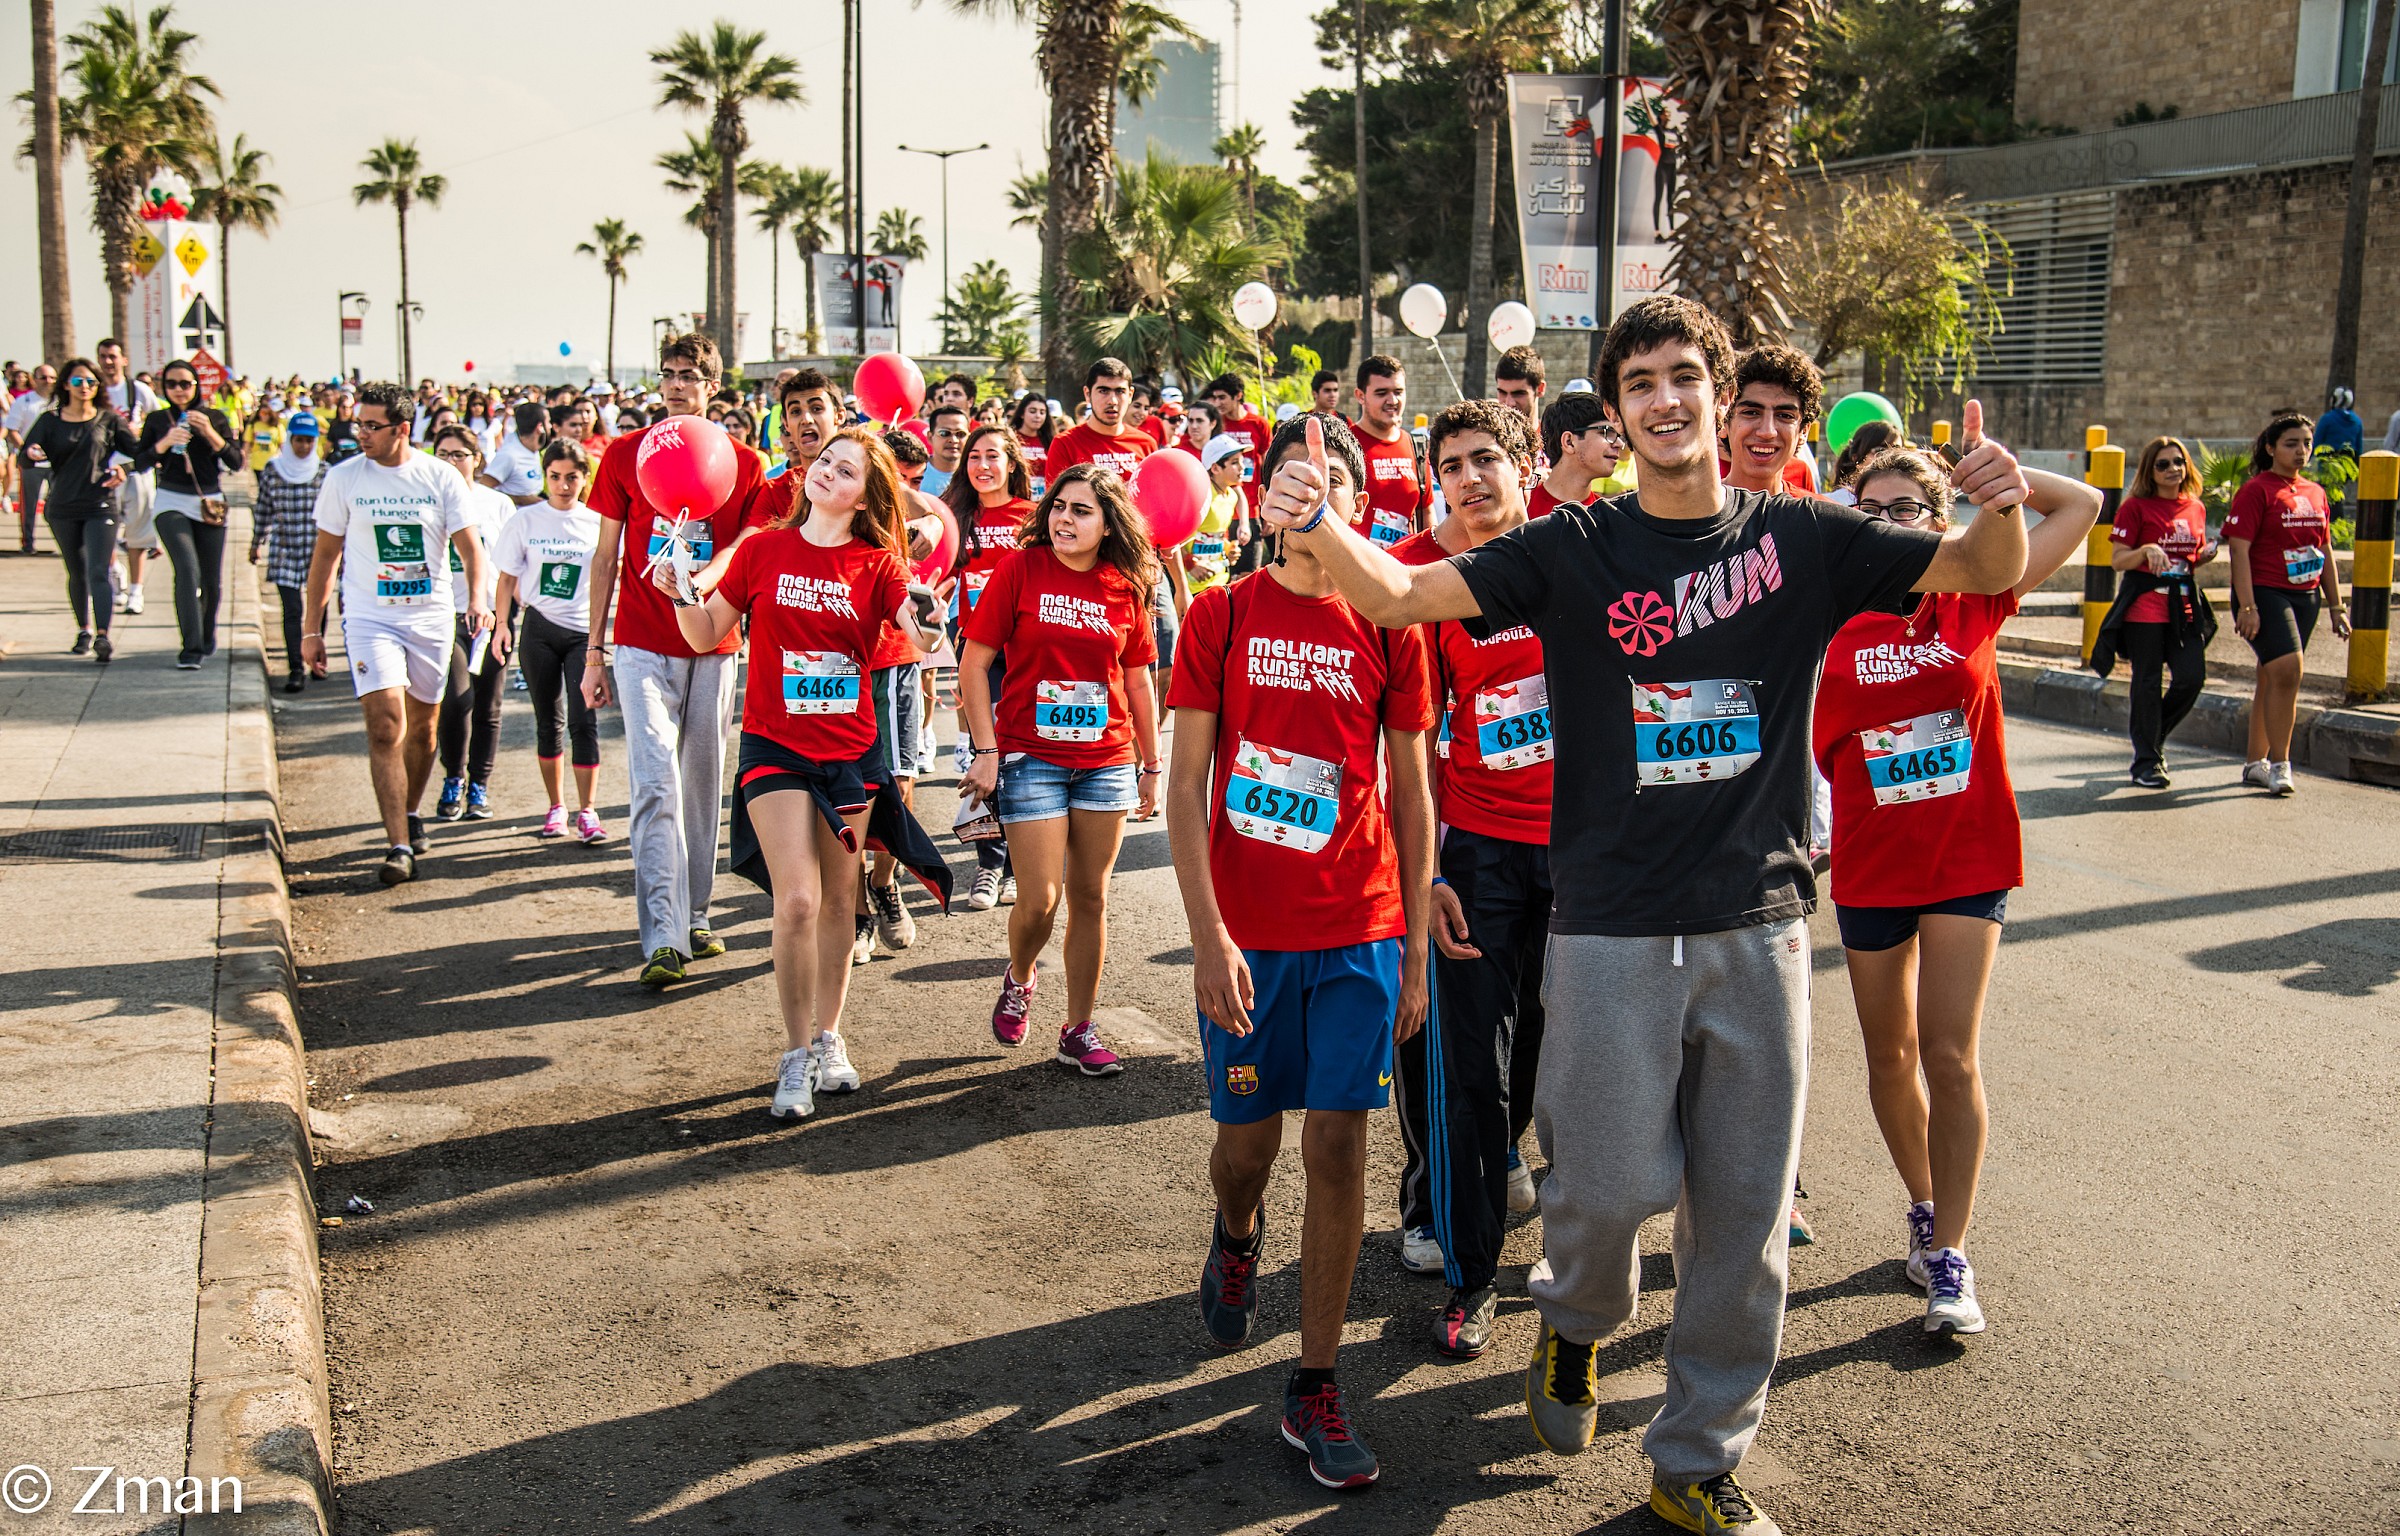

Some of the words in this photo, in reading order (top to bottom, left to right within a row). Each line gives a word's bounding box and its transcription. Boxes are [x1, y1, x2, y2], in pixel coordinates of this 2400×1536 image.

[1567, 156, 1591, 165] 2013
[139, 236, 149, 250] 2
[188, 239, 197, 252] 2
[1539, 263, 1588, 290] Rim
[356, 497, 380, 506] Run
[383, 496, 397, 505] to
[400, 495, 437, 505] Crash
[371, 509, 420, 520] Hunger
[1380, 527, 1406, 541] 639
[542, 547, 583, 560] Hunger
[383, 580, 427, 595] 19295
[1674, 532, 1783, 638] RUN
[797, 677, 846, 698] 6466
[1049, 706, 1098, 726] 6495
[1655, 720, 1737, 759] 6606
[1888, 746, 1957, 783] 6465
[1244, 786, 1318, 827] 6520
